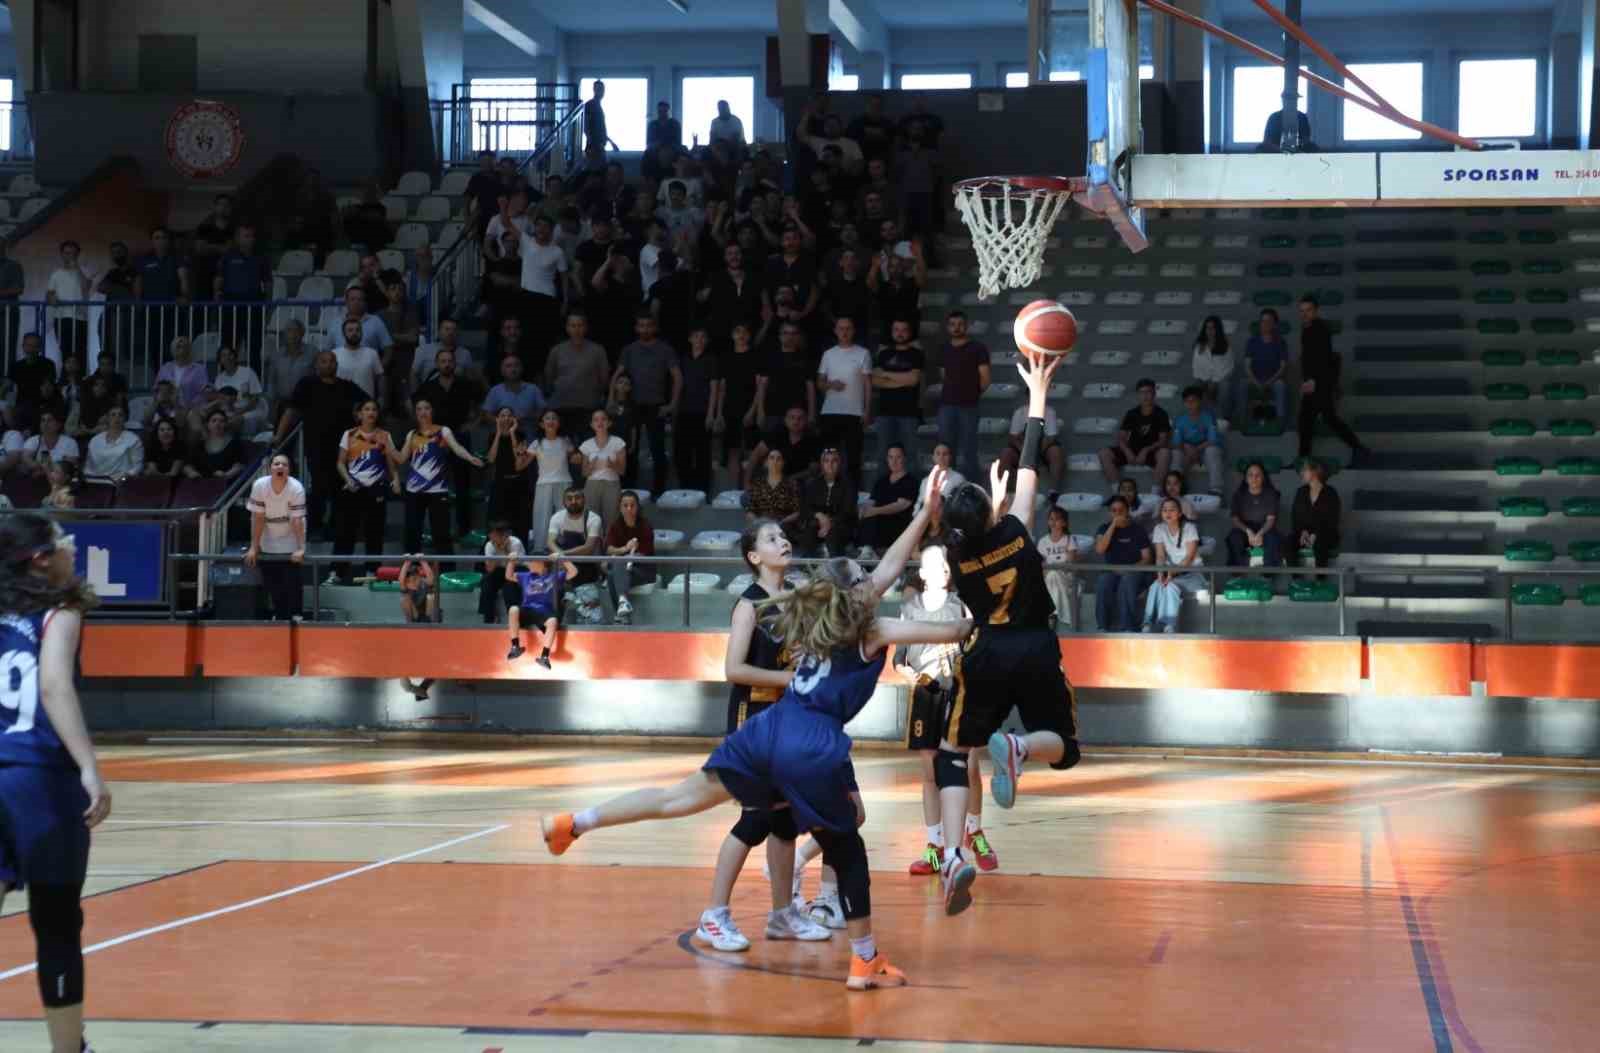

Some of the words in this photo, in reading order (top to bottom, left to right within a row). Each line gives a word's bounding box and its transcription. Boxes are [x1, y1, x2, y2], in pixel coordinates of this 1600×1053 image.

[1443, 168, 1540, 182] SPORSAN
[1555, 169, 1573, 180] TEL.
[985, 565, 1019, 626] 7
[0, 648, 39, 735] 9
